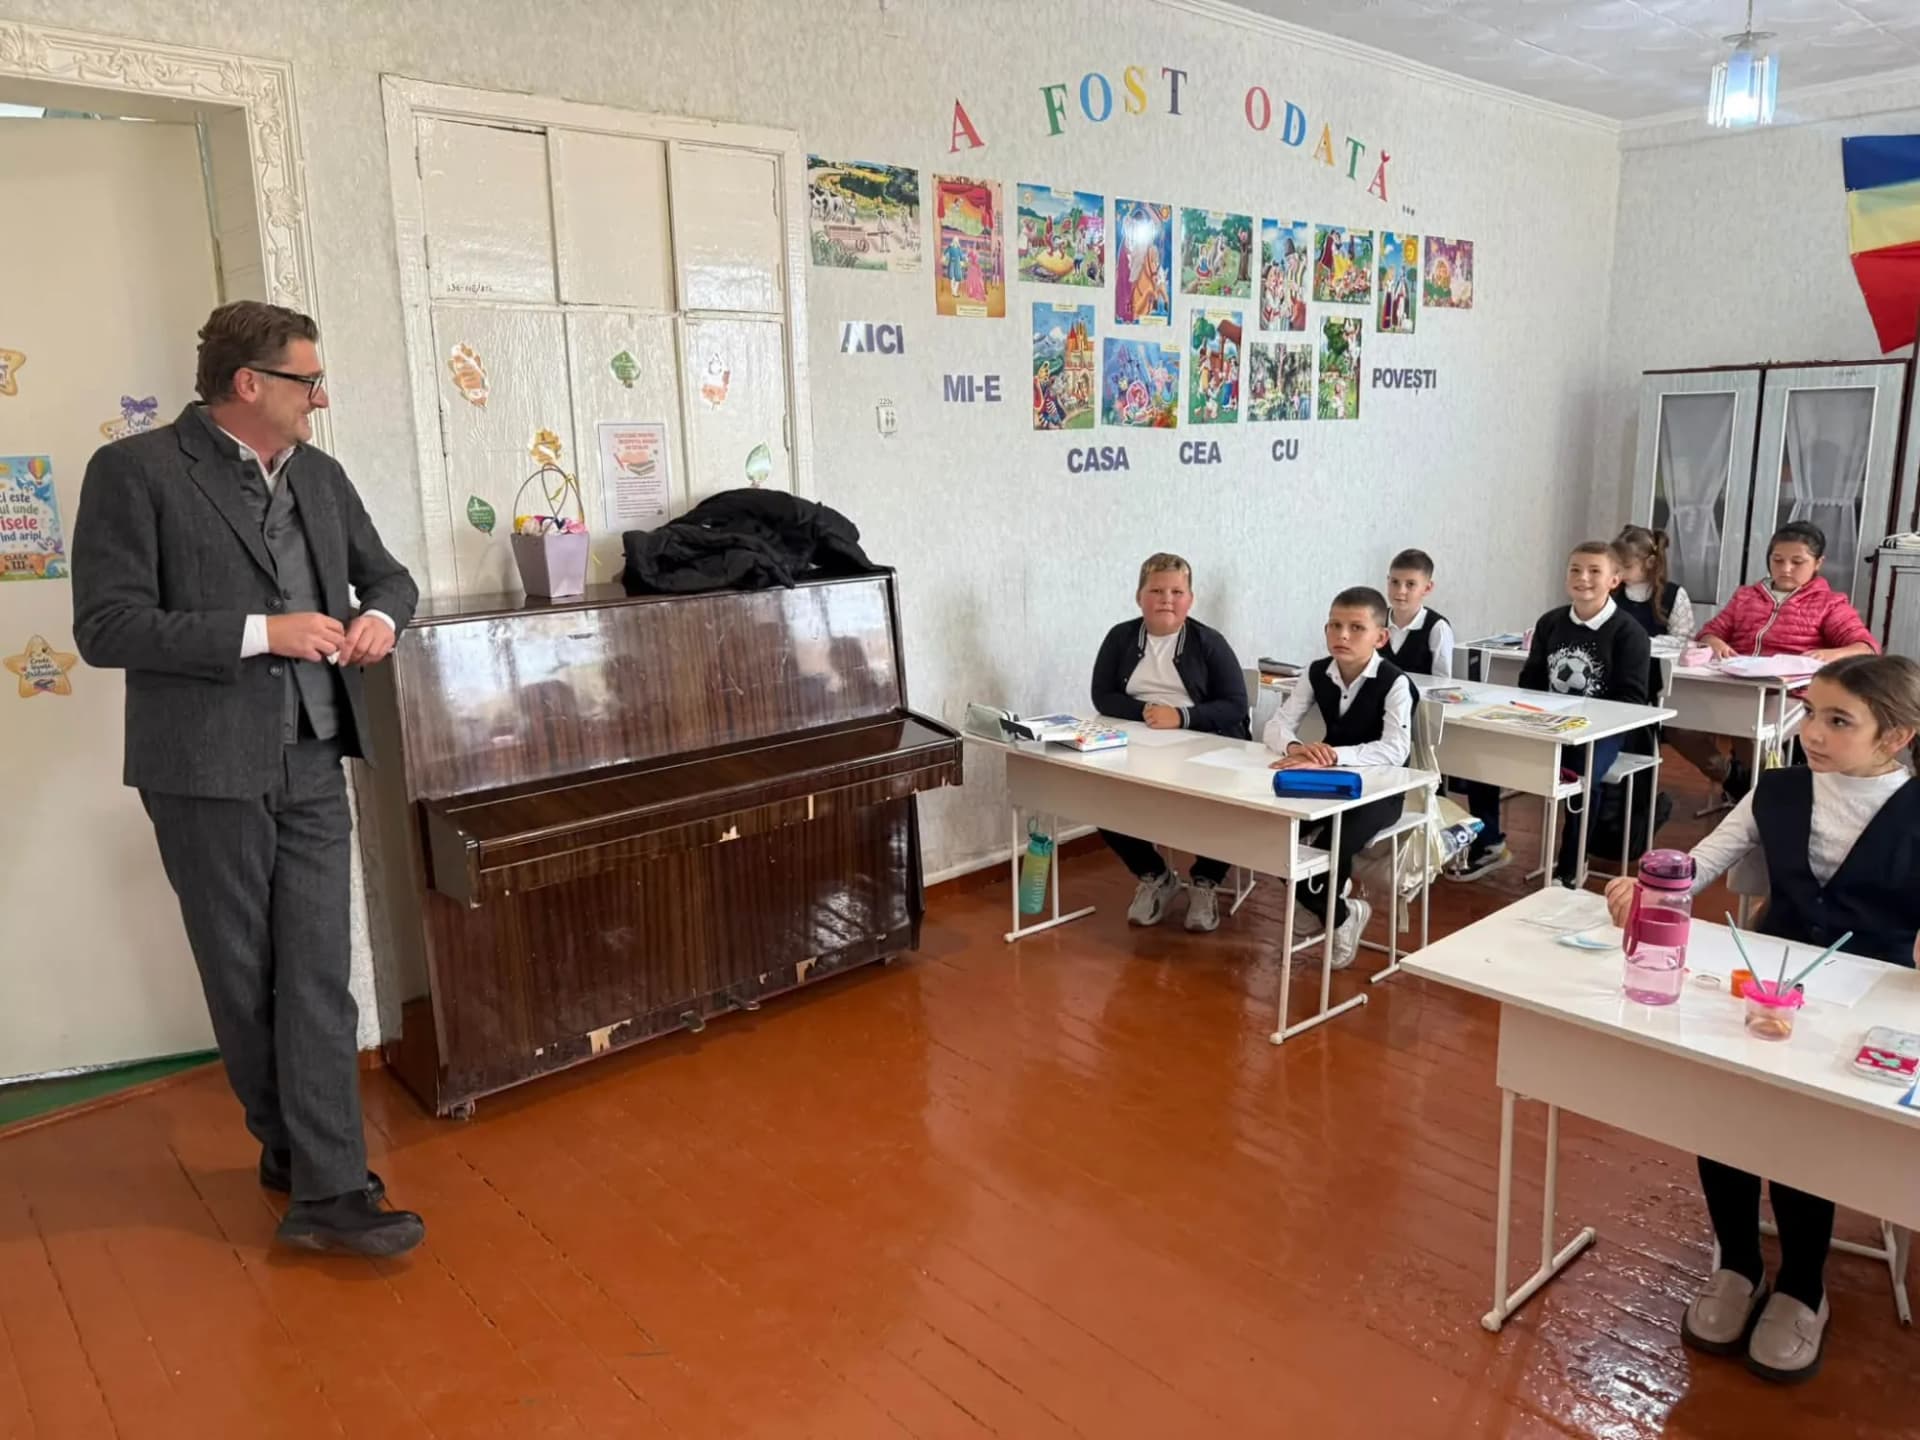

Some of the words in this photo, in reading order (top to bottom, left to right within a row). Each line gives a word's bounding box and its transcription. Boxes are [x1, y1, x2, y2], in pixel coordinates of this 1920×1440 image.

[949, 97, 985, 153] A
[1039, 65, 1188, 136] FOST
[943, 374, 1003, 402] MI-E
[1067, 446, 1130, 473] CASA
[1179, 441, 1223, 464] CEA
[1272, 439, 1300, 461] CU
[1372, 367, 1437, 395] POVEȘTI
[9, 493, 31, 503] este
[12, 503, 39, 515] unde
